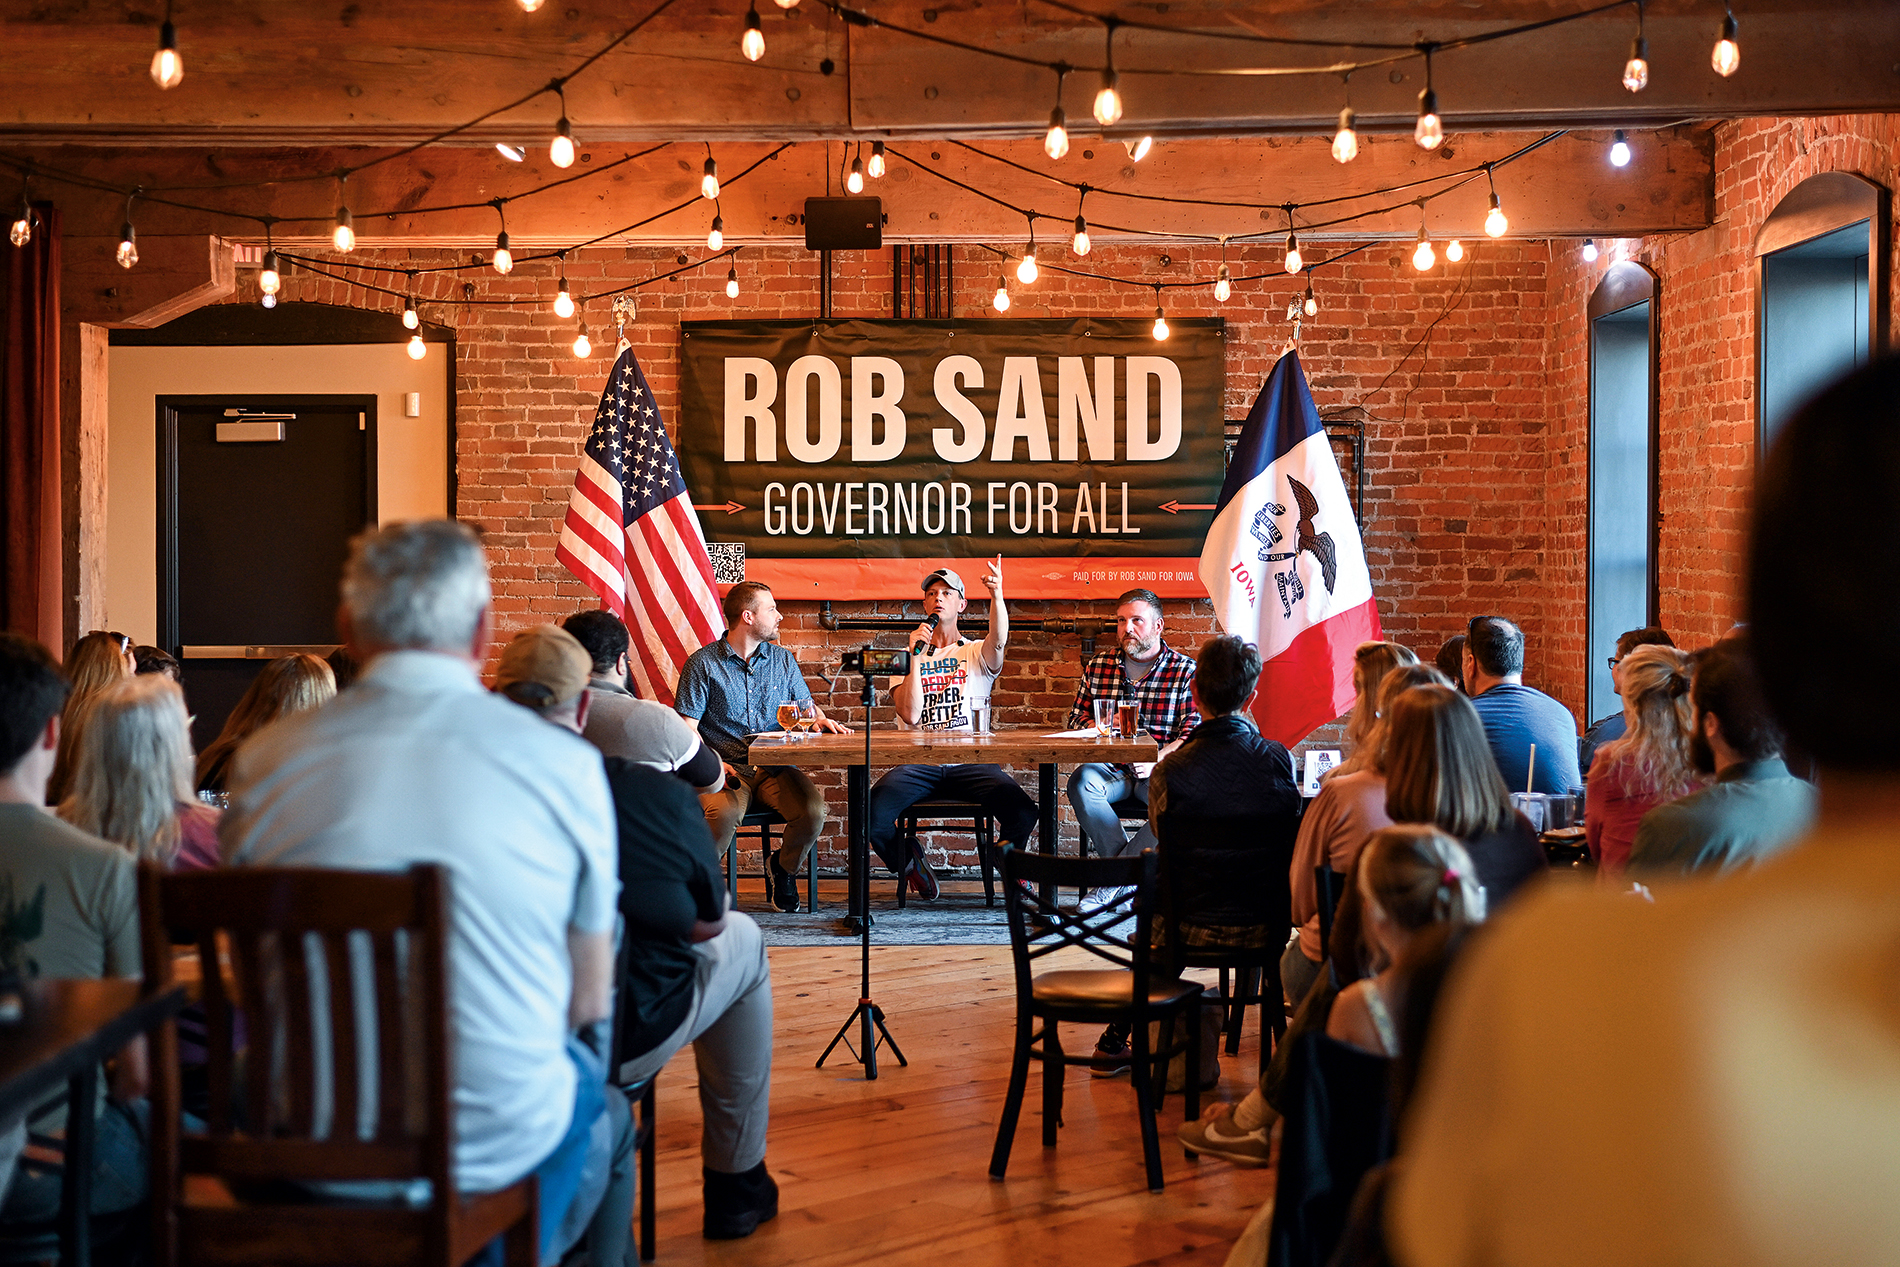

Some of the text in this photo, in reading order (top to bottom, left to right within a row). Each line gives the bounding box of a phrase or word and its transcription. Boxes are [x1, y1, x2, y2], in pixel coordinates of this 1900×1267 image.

[724, 355, 1182, 463] ROB SAND
[764, 482, 1141, 535] GOVERNOR FOR ALL
[1267, 503, 1279, 515] OUR
[1256, 511, 1281, 538] LIBERTIES
[1073, 571, 1089, 582] PAID
[1091, 571, 1106, 581] FOR
[1108, 571, 1118, 581] BY
[1120, 571, 1135, 581] ROB
[1137, 571, 1157, 581] SAND
[1159, 571, 1174, 581] FOR
[1175, 571, 1195, 582] IOWA
